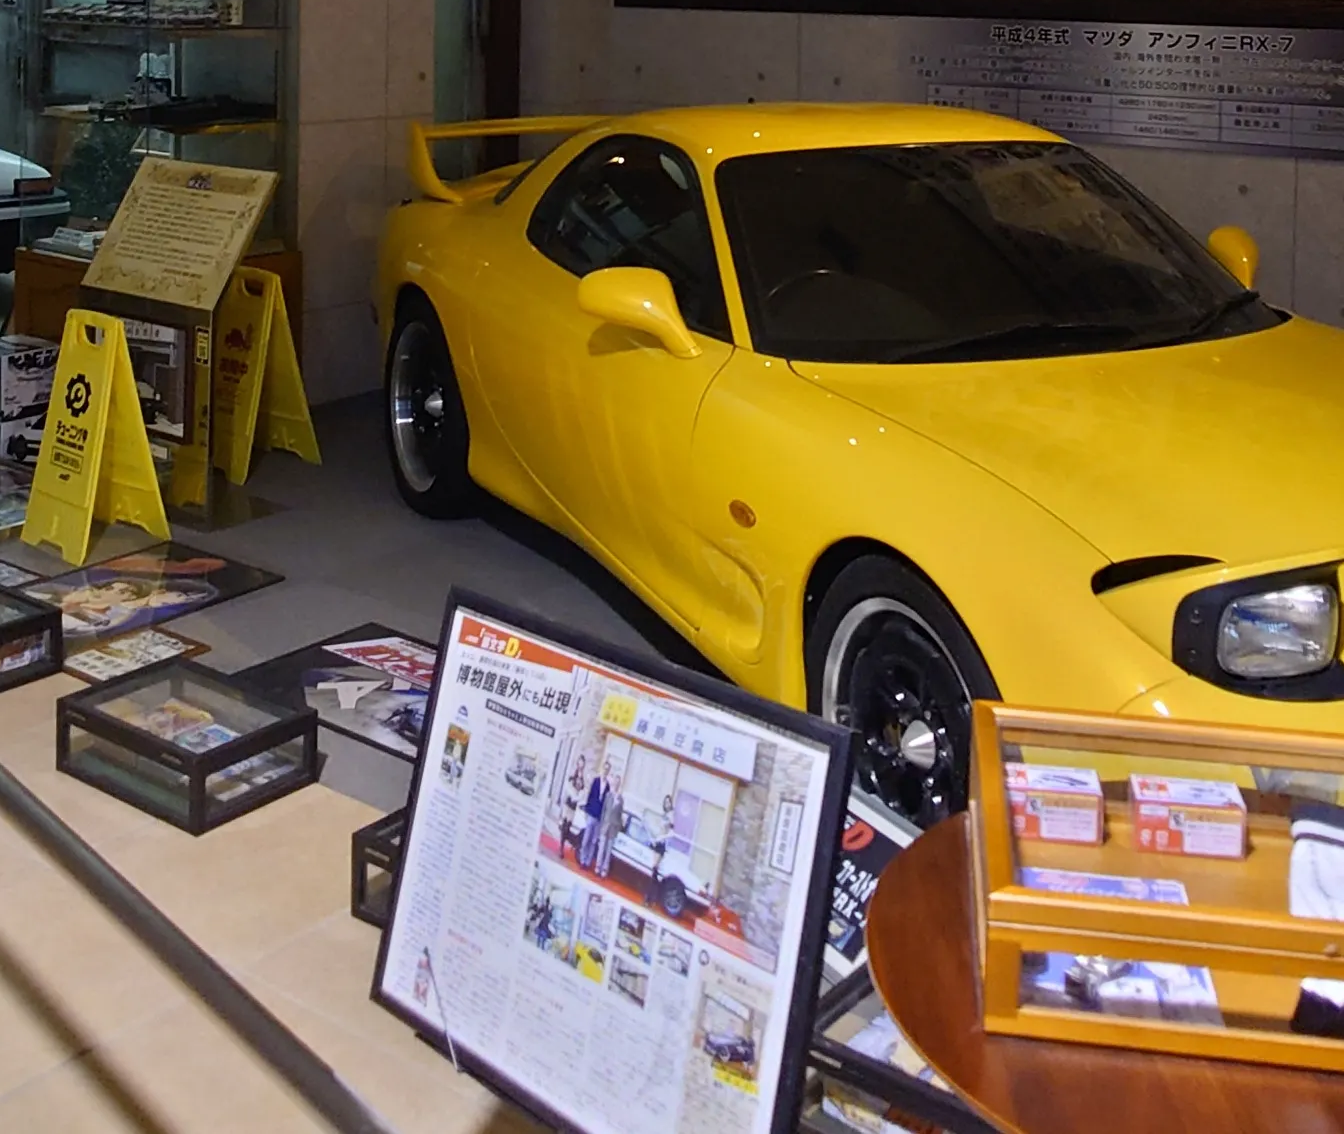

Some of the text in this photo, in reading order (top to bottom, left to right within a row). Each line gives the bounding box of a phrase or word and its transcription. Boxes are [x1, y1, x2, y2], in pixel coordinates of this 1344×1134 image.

[991, 26, 1071, 46] 平成4年式
[1083, 30, 1134, 48] マツダ
